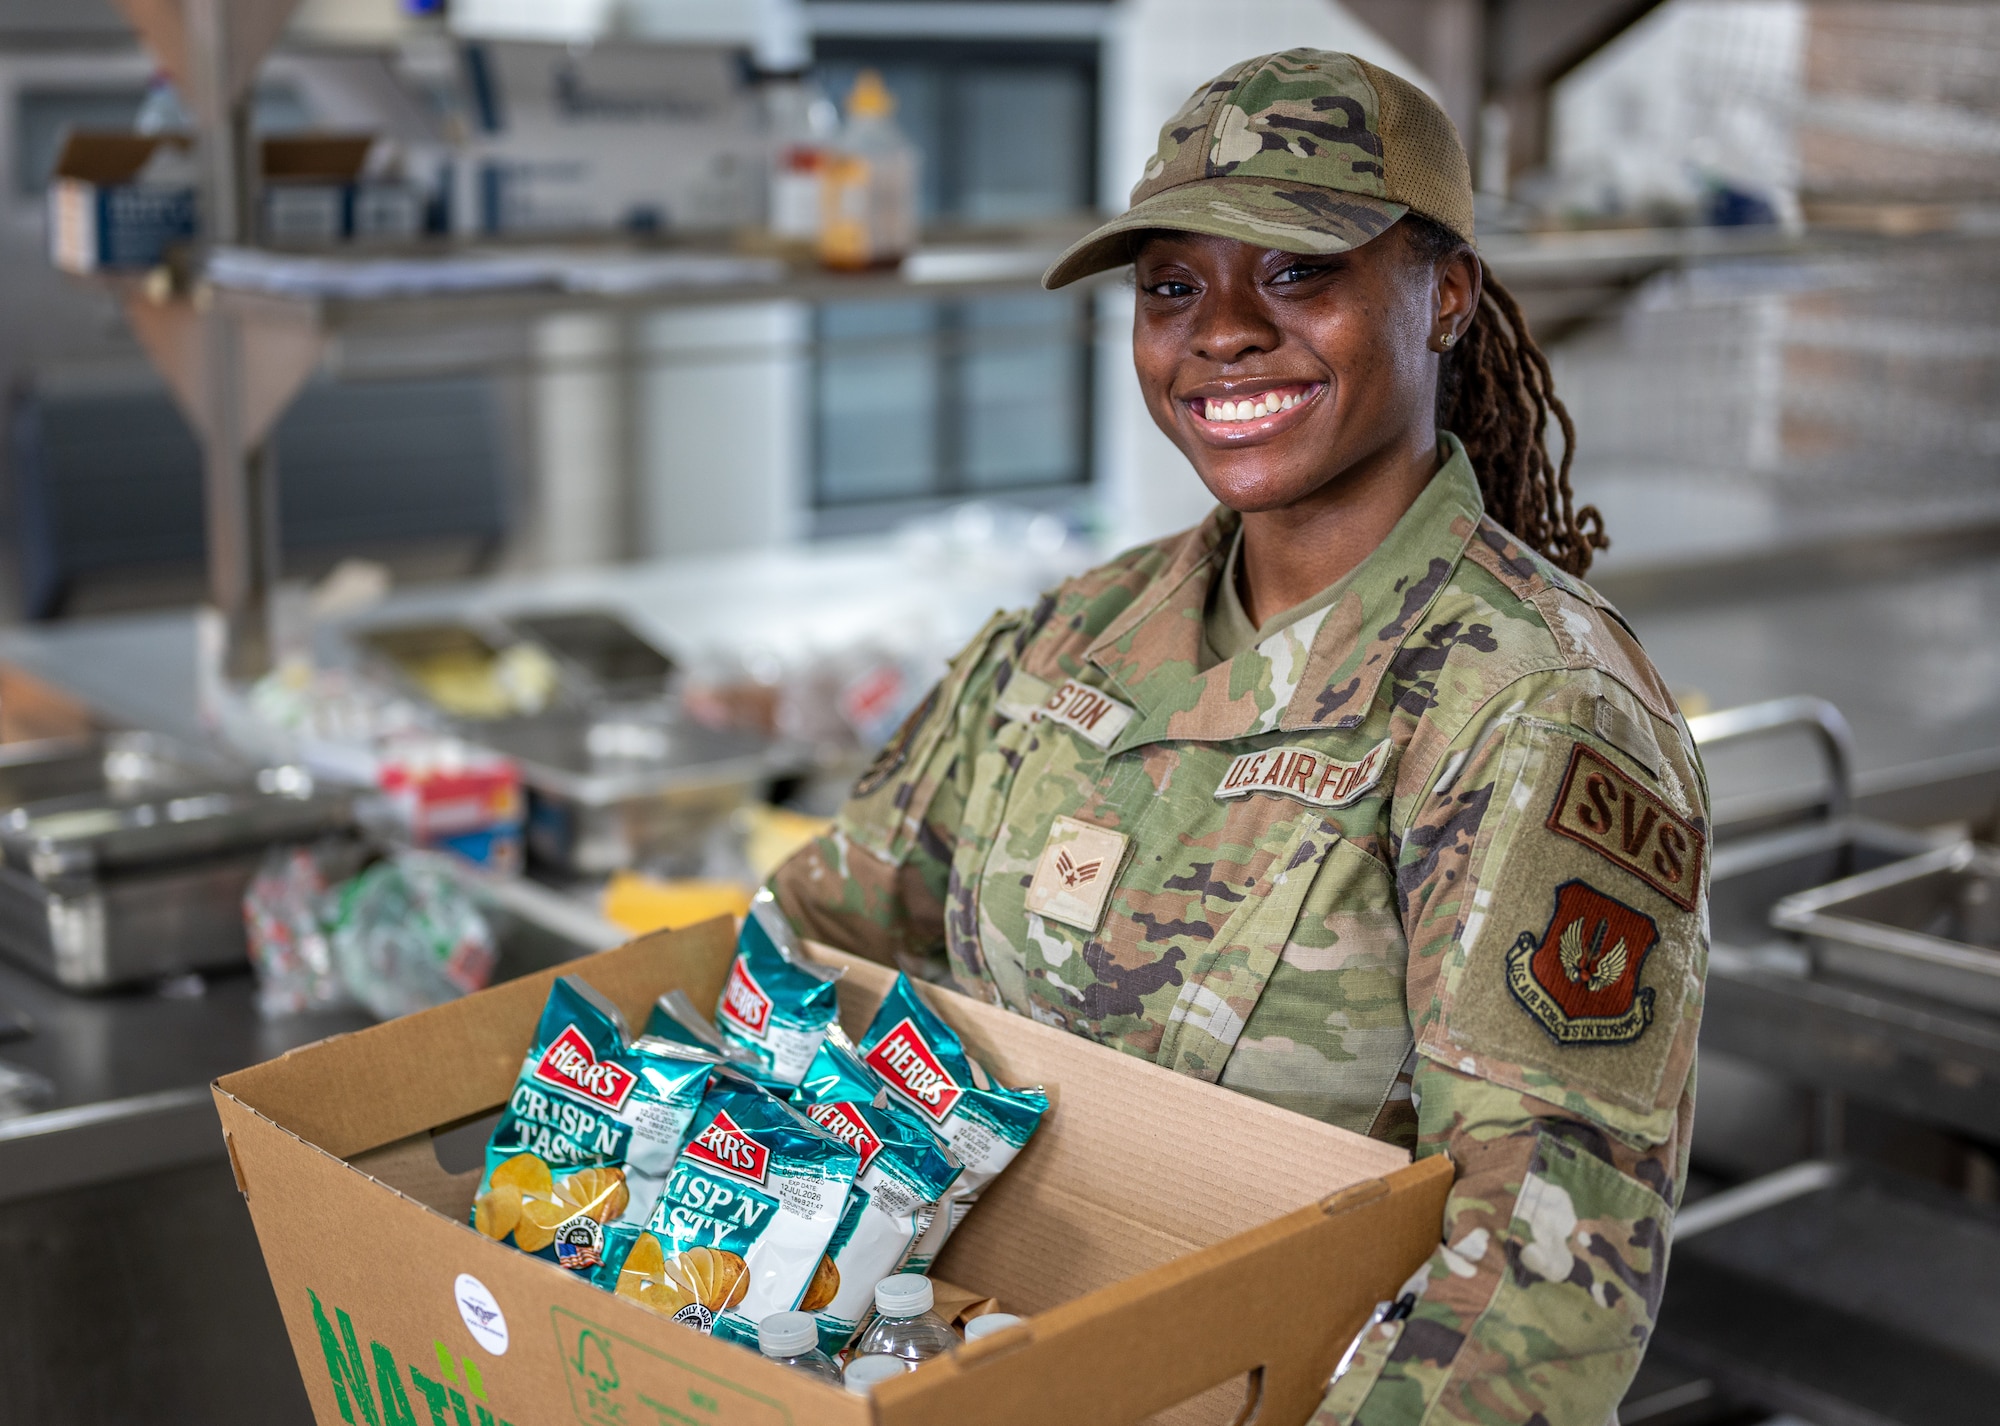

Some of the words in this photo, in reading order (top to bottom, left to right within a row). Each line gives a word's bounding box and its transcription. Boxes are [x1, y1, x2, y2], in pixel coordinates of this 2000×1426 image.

[1031, 683, 1112, 731] STON
[1225, 754, 1267, 789] U.S.
[1261, 751, 1317, 795] AIR
[1314, 747, 1381, 801] FOCE
[1577, 771, 1686, 883] SVS
[1519, 984, 1541, 1007] AIR
[548, 1040, 622, 1097] HERR'S
[880, 1033, 948, 1106] HERR'S
[692, 1122, 757, 1170] ERR'S
[780, 1182, 822, 1202] 12JUL2026
[556, 1217, 582, 1242] FAMILY
[569, 1234, 590, 1246] USA
[644, 1201, 739, 1249] ASTY
